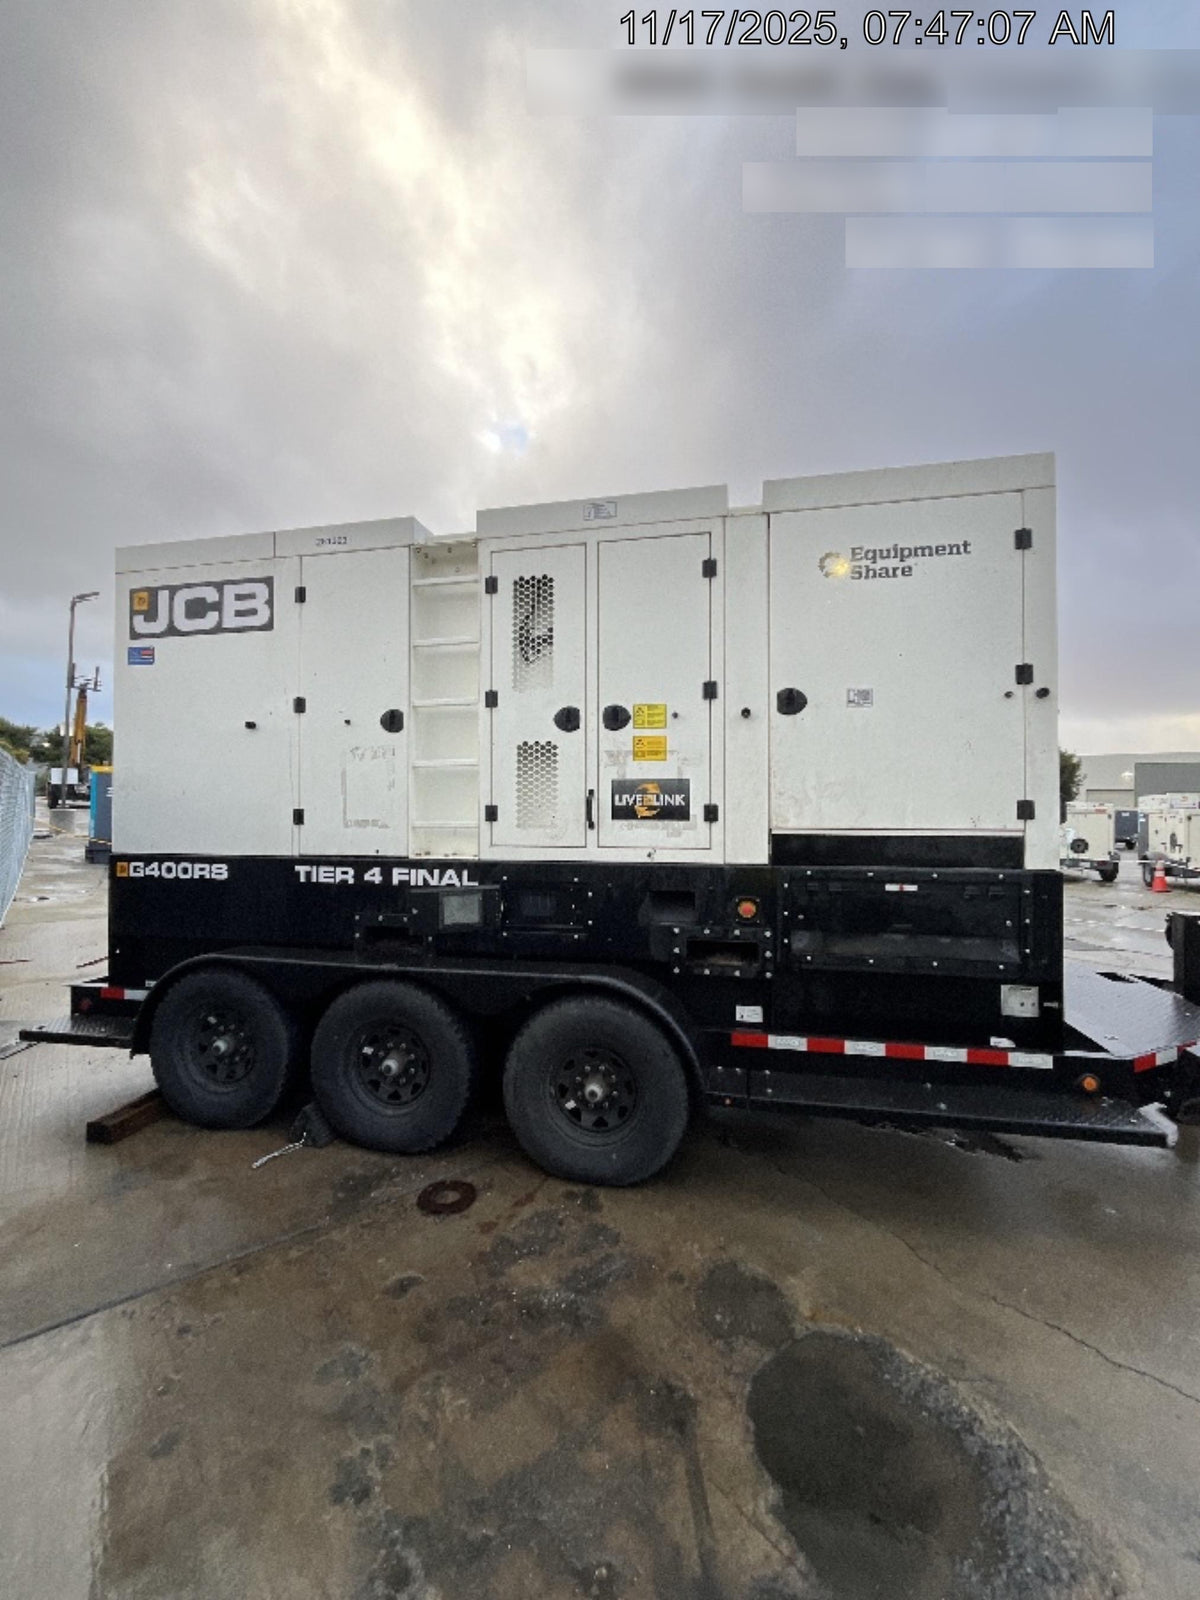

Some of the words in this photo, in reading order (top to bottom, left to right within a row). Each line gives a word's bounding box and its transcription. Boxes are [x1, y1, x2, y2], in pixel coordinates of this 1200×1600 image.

[850, 540, 971, 564] Equipment
[850, 564, 913, 580] Share
[132, 582, 271, 634] JCB
[294, 865, 355, 884] TIER
[363, 867, 383, 884] 4
[392, 867, 479, 887] FINAL
